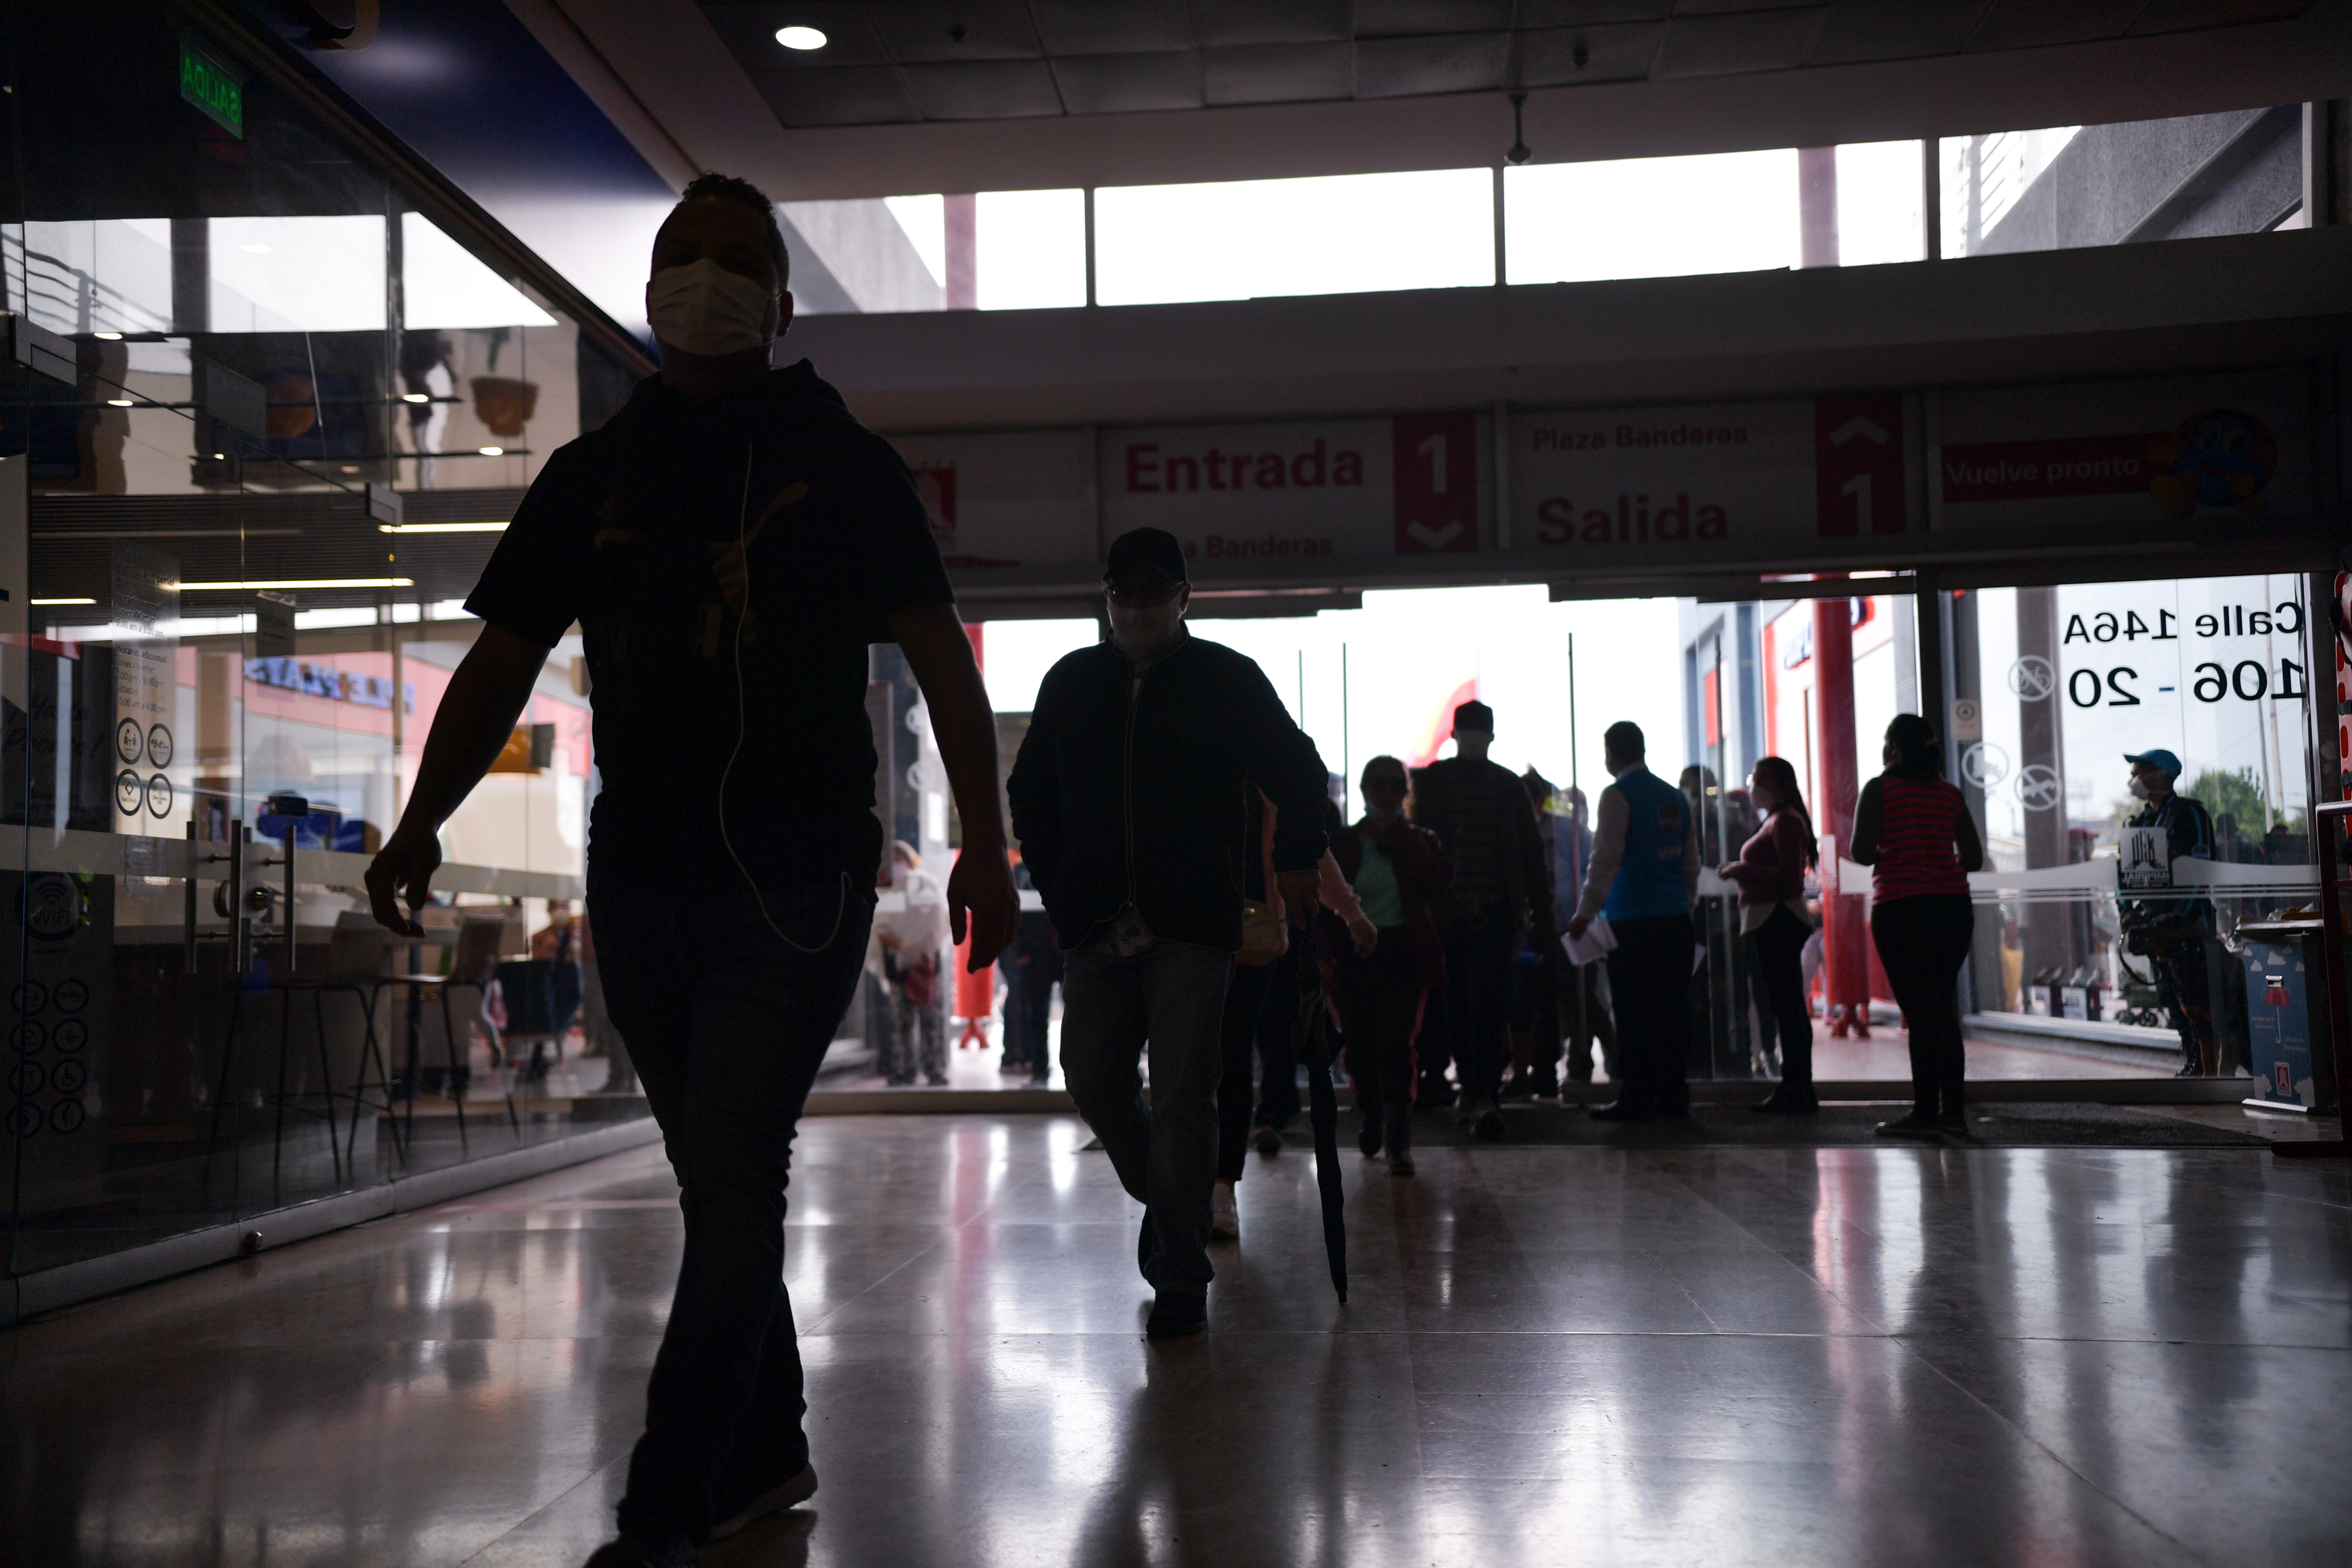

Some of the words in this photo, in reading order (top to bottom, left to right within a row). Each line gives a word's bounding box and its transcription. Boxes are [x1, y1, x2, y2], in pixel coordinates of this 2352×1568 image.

[1534, 427, 1606, 451] Plaza
[1616, 424, 1748, 448] Banderas
[1127, 439, 1364, 491] Entrada
[1417, 433, 1448, 493] 1
[1945, 460, 2039, 485] Vuelve
[2047, 456, 2140, 486] pronto
[1841, 472, 1872, 534] 1
[1536, 493, 1729, 545] Salida
[1207, 534, 1332, 557] Banderas
[116, 618, 128, 629] 9:00
[155, 630, 164, 639] pm
[116, 644, 139, 657] Horario
